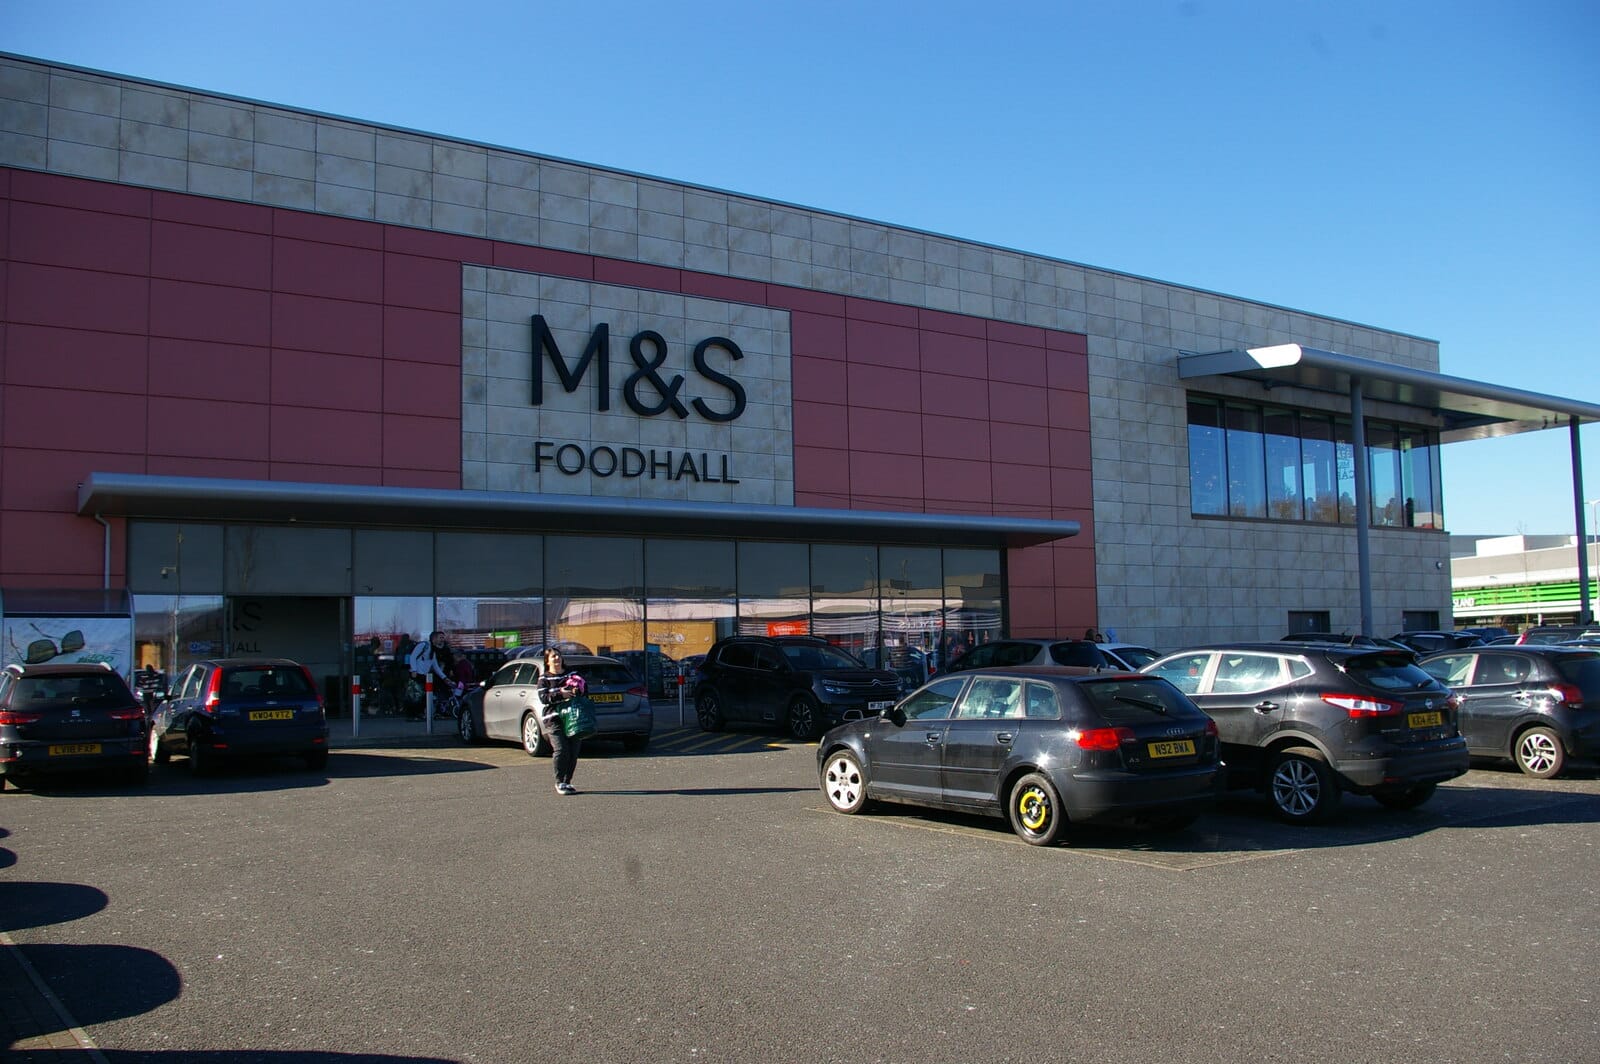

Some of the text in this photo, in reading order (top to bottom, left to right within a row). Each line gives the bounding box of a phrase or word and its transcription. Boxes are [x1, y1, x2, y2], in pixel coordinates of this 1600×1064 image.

[531, 314, 747, 422] M&S
[534, 441, 740, 484] FOODHALL
[1155, 741, 1190, 755] N92 BWA
